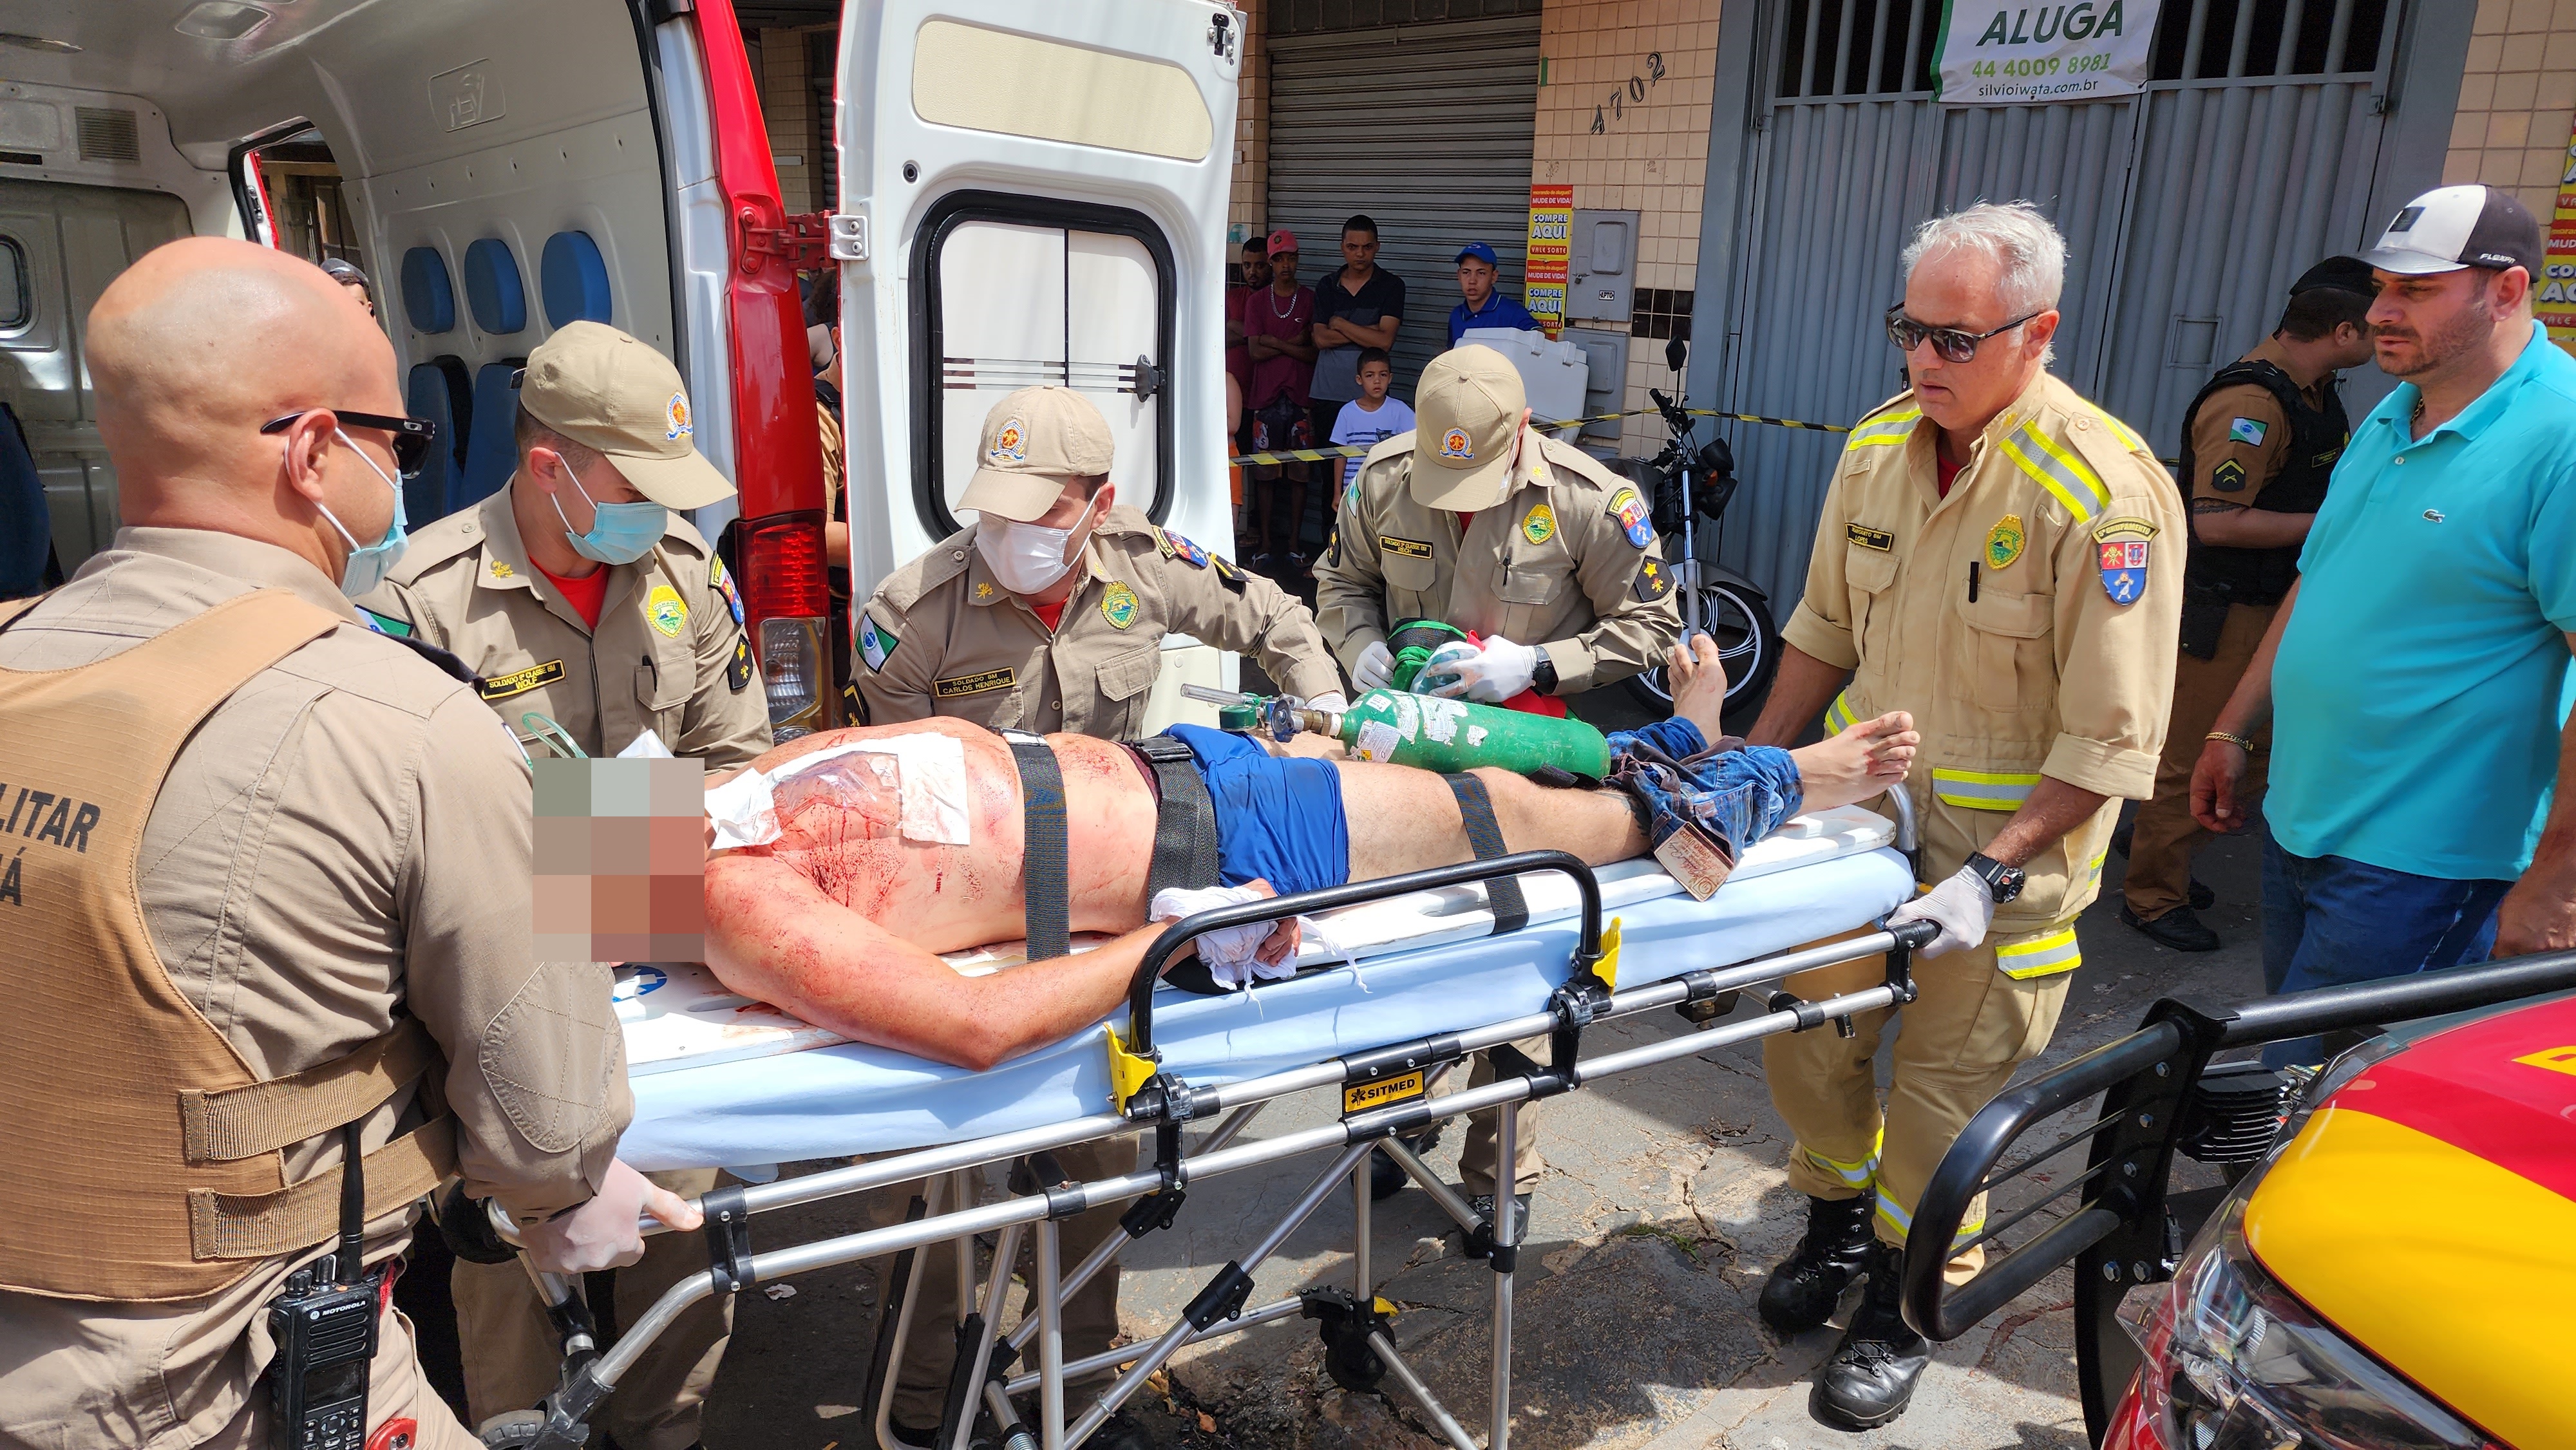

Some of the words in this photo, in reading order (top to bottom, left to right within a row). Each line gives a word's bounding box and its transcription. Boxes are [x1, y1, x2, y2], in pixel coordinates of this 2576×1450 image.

[1976, 0, 2123, 47] ALUGA
[1972, 60, 1996, 79] 44
[2003, 57, 2061, 77] 4009
[2068, 53, 2111, 75] 8981
[1591, 51, 1665, 135] 4702
[1979, 79, 2099, 97] silvioiwata.com.br
[1533, 214, 1568, 223] COMPRE
[1531, 225, 1567, 240] AQUI
[1528, 288, 1563, 298] COMPRE
[1528, 299, 1563, 314] AQUI
[1855, 535, 1868, 544] LOPES
[489, 677, 518, 688] SOLDADO
[526, 667, 547, 679] CLASSE
[515, 677, 538, 690] WOLF
[942, 684, 973, 695] CARLOS
[975, 676, 1011, 690] HENRIQUE
[952, 676, 985, 687] SOLDADO
[1367, 1078, 1416, 1099] SITMED
[322, 1300, 366, 1316] MOTOROLA
